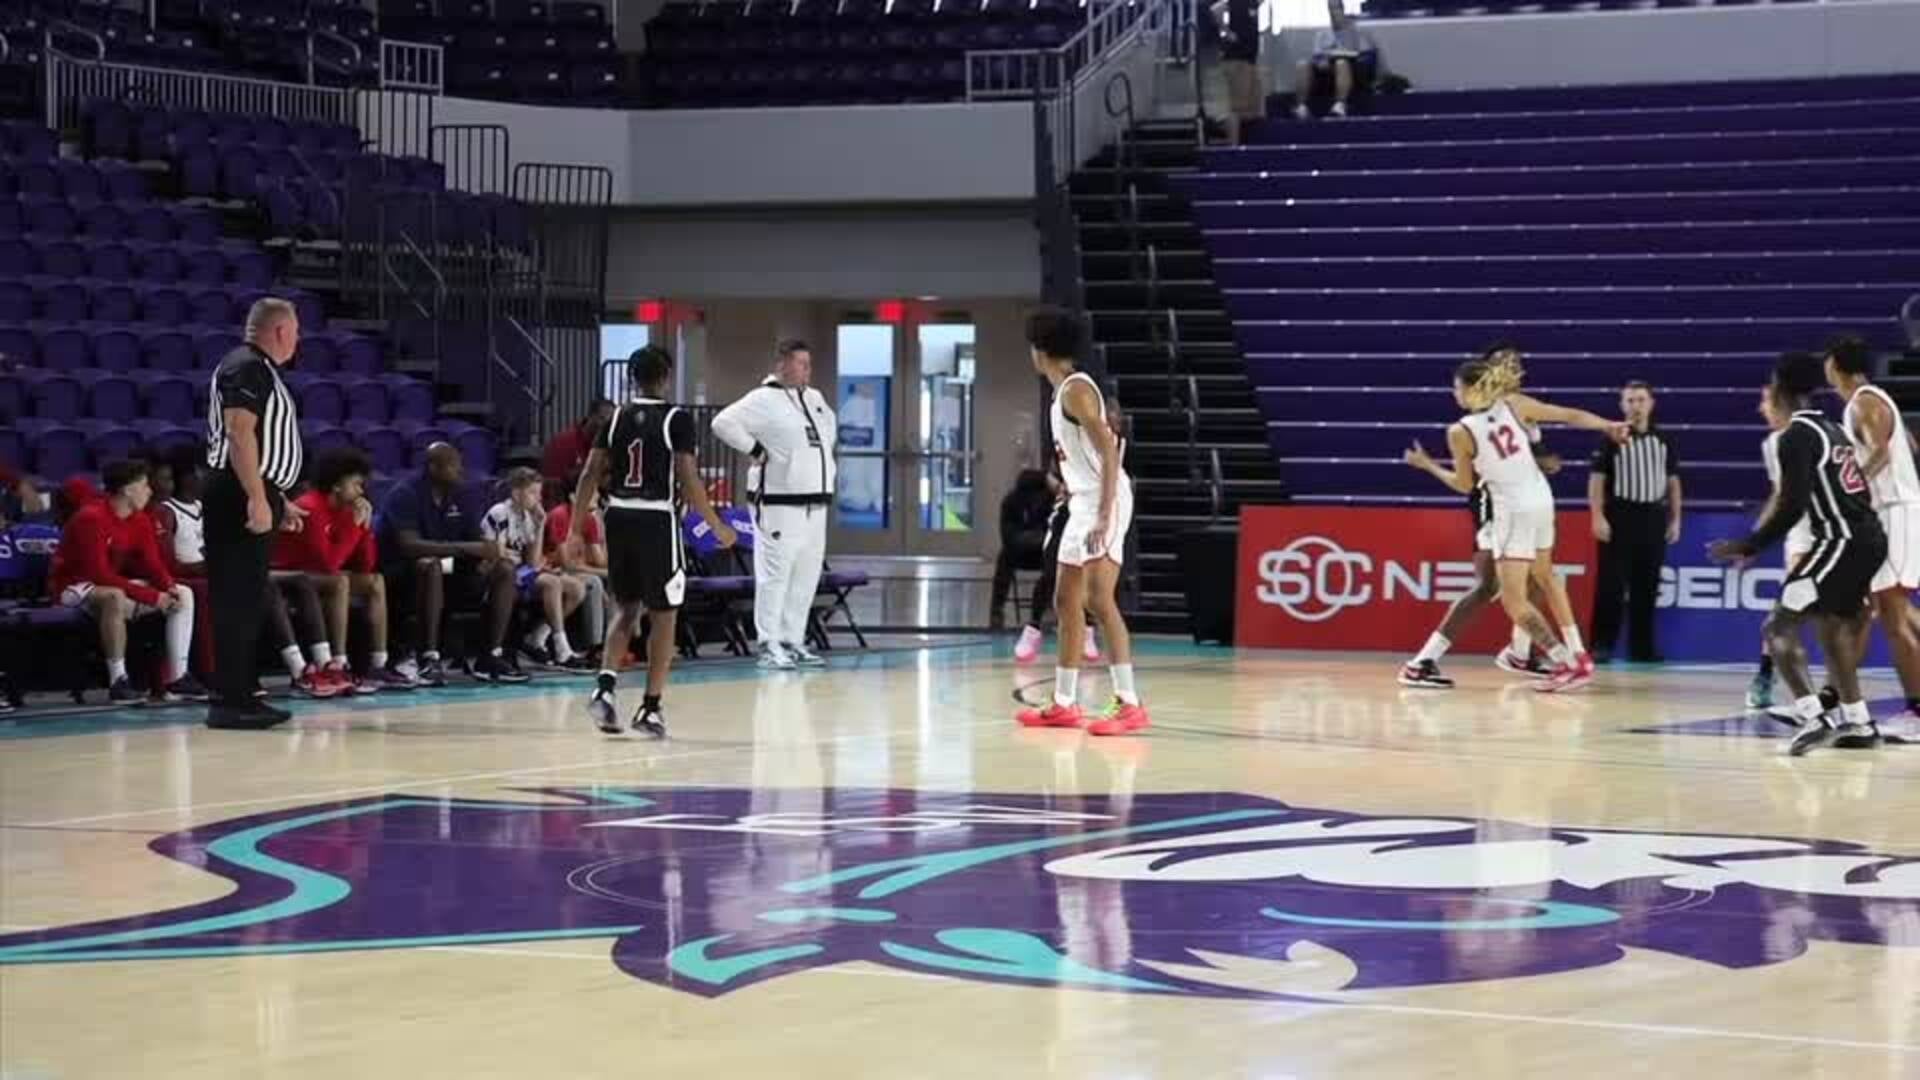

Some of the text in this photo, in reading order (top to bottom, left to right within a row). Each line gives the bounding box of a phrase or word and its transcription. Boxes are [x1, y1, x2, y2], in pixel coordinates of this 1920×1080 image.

[624, 437, 644, 488] 1
[1487, 425, 1521, 460] 12
[1383, 560, 1586, 602] NET
[1654, 565, 1785, 611] EIC
